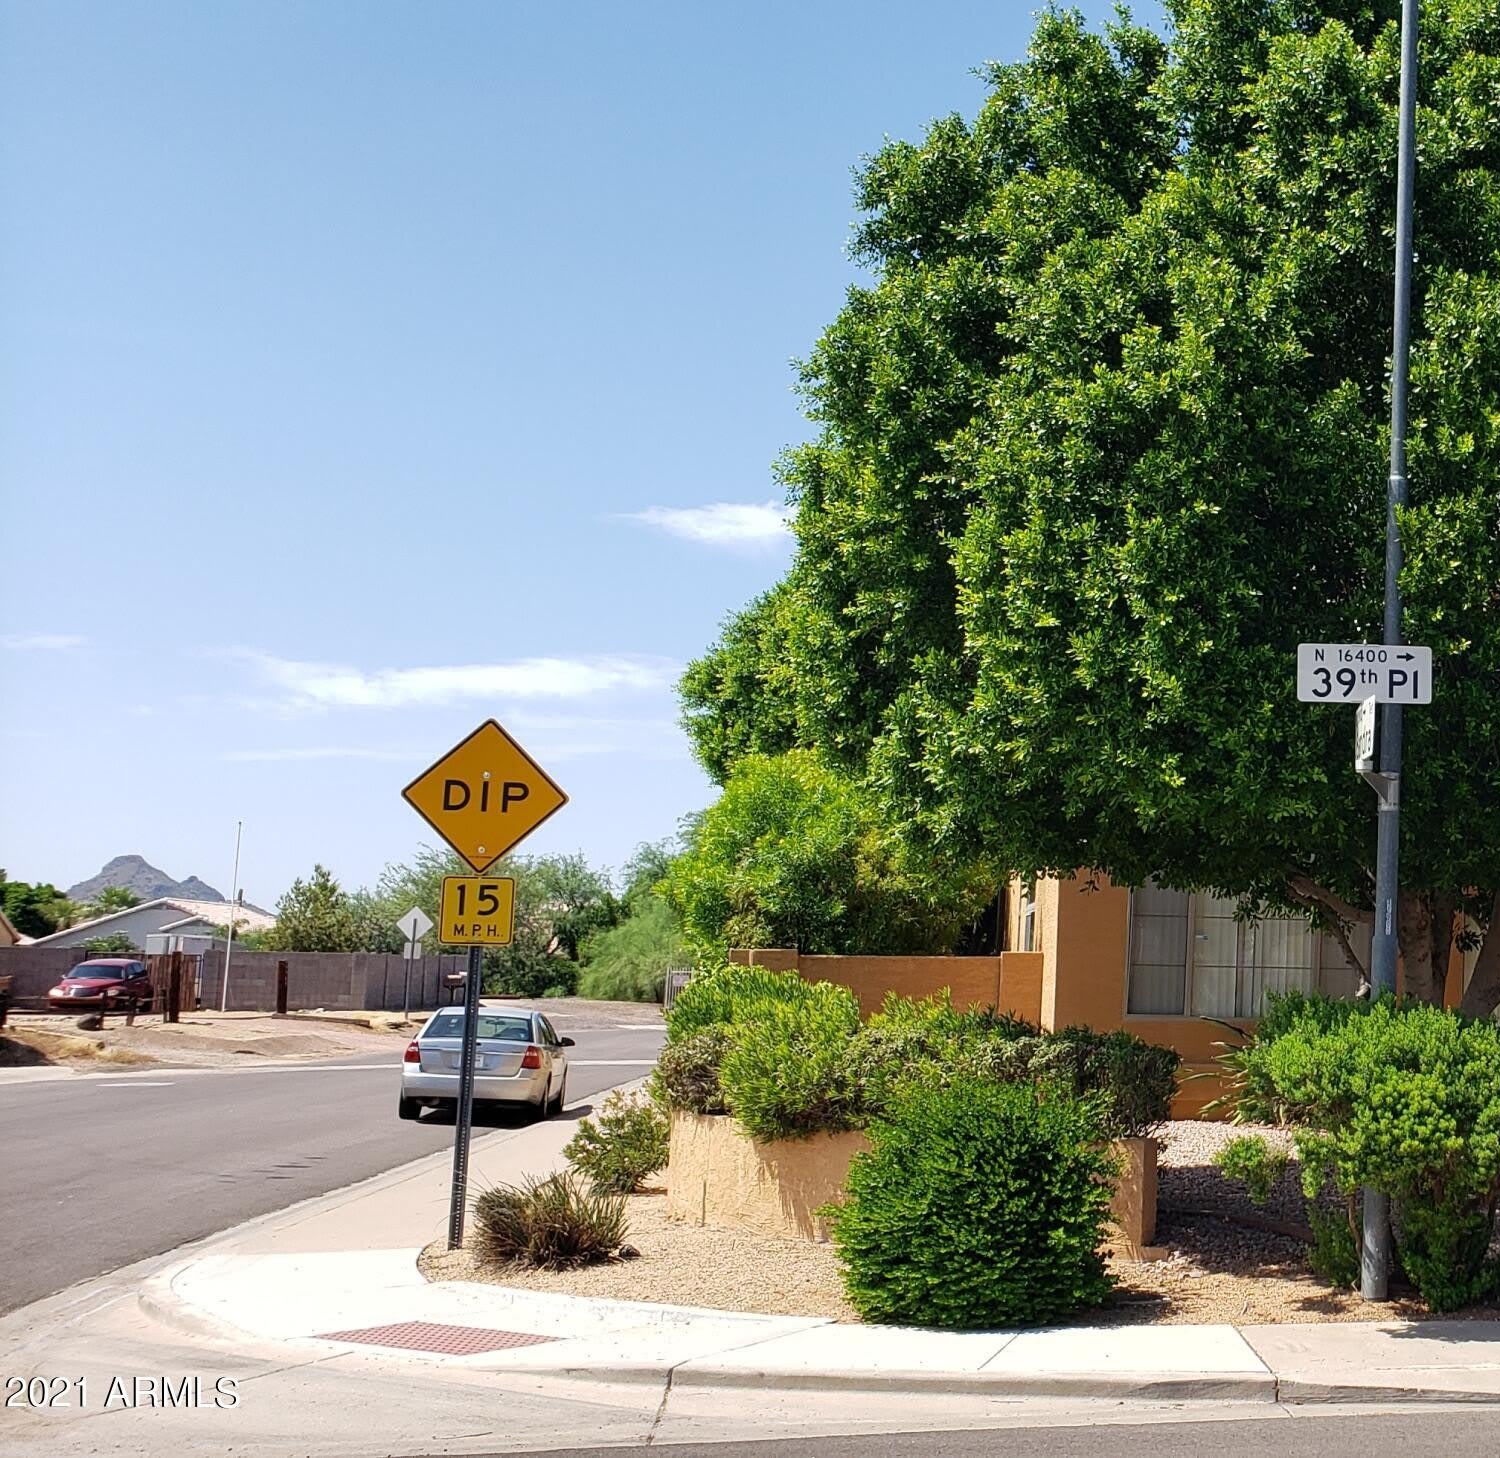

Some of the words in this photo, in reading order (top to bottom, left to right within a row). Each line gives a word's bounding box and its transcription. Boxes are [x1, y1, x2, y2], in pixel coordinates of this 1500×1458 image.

[1315, 648, 1325, 662] N
[1338, 649, 1388, 663] 16400
[1312, 667, 1378, 698] 39th
[443, 779, 530, 813] DIP
[457, 883, 500, 916] 15
